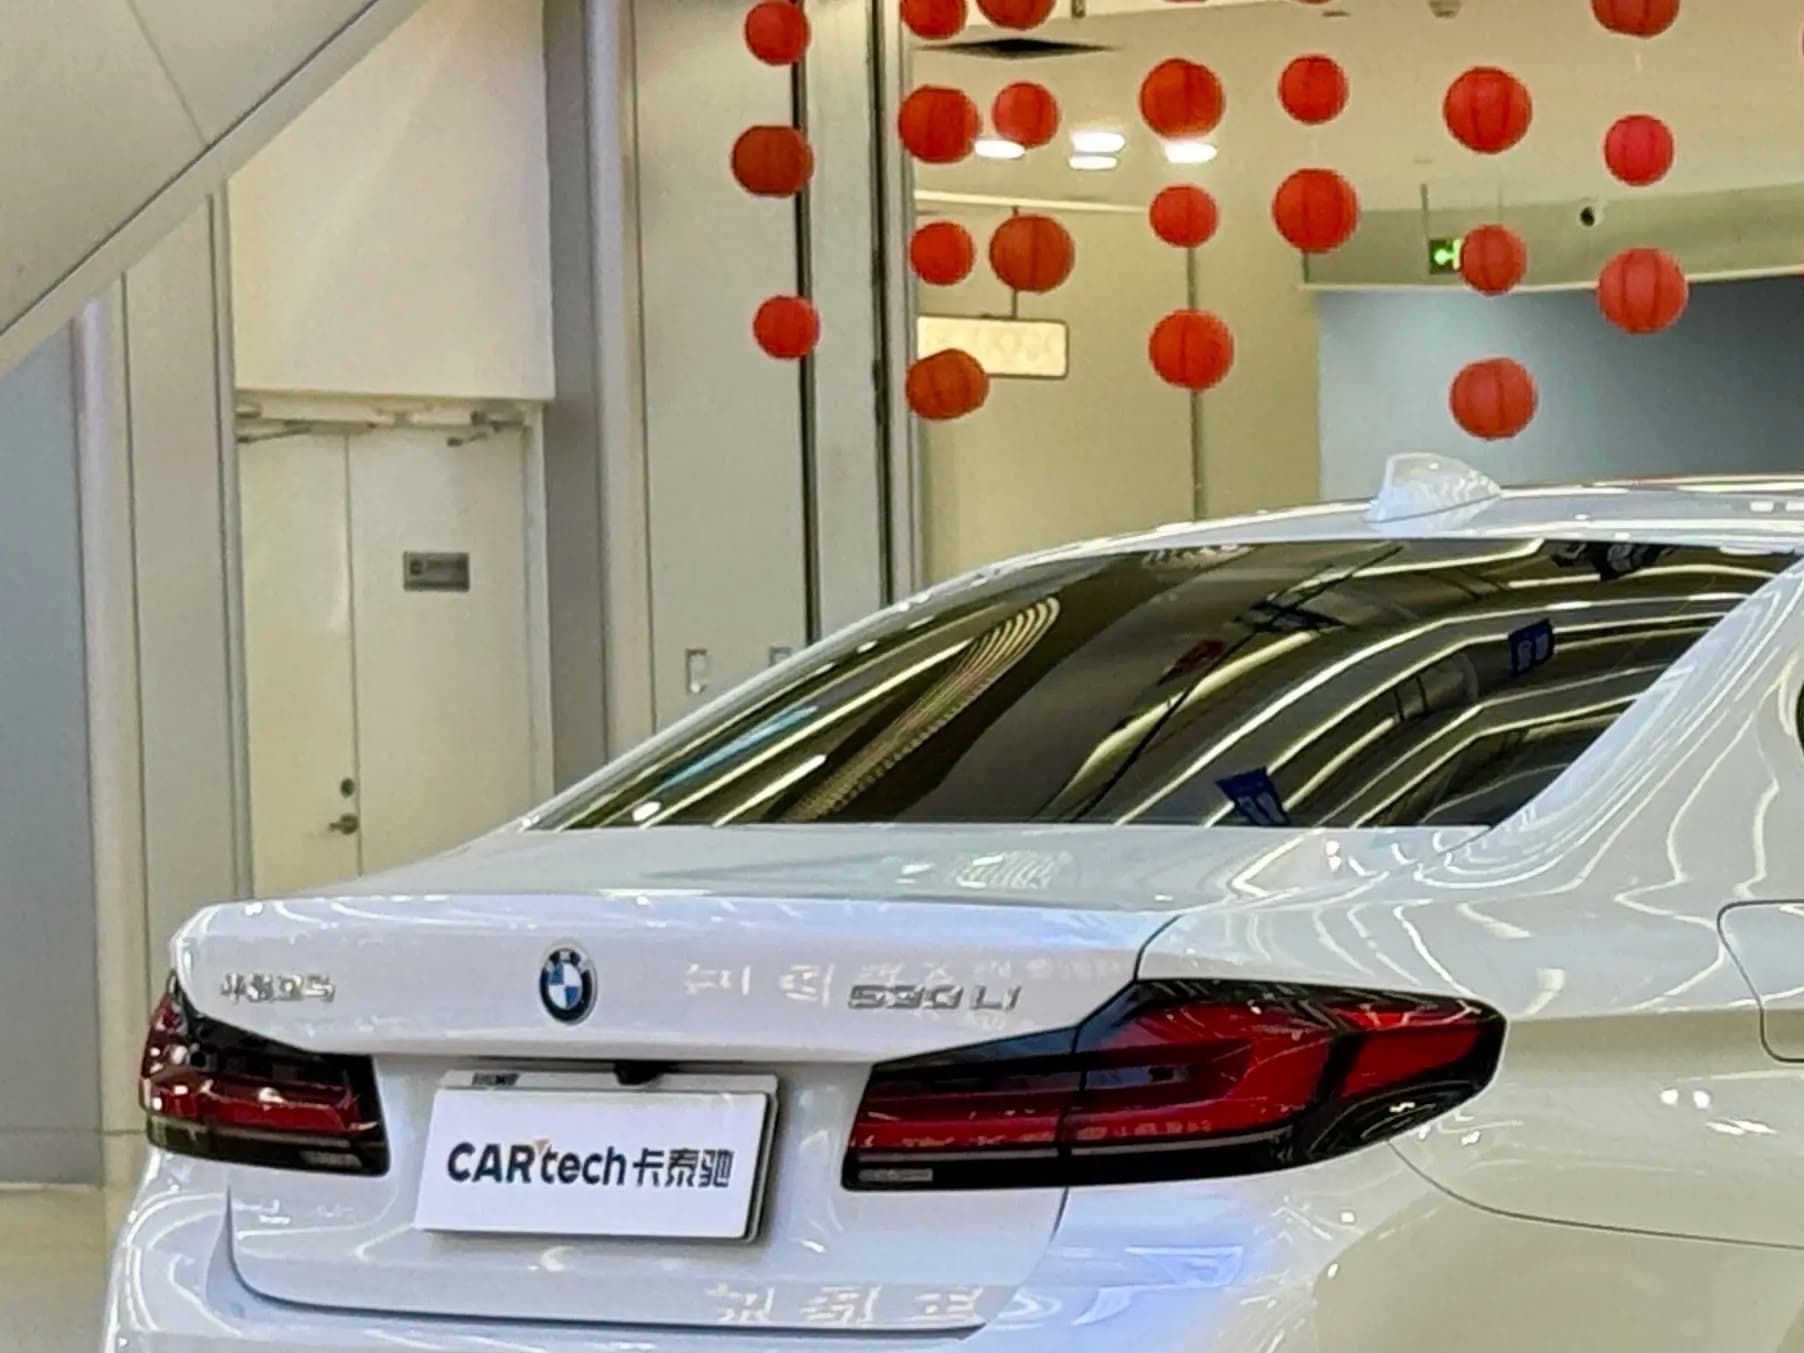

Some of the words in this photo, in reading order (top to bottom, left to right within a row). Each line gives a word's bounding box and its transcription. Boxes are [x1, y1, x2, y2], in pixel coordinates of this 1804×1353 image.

[447, 1140, 627, 1187] CARtech
[632, 1146, 735, 1188] 卡泰驰
